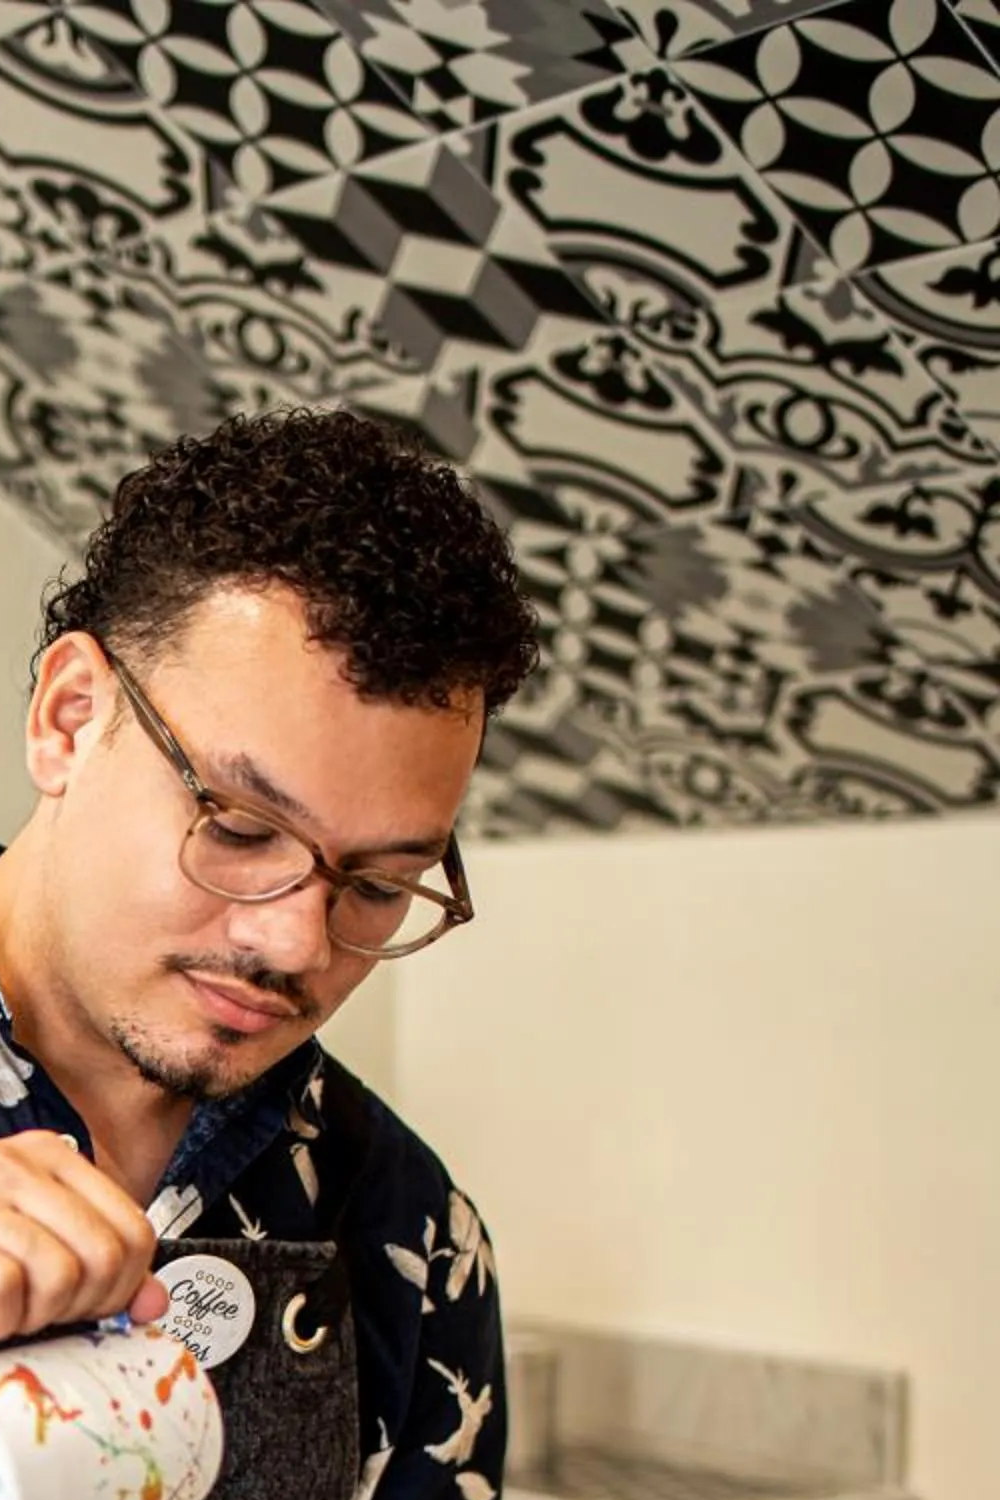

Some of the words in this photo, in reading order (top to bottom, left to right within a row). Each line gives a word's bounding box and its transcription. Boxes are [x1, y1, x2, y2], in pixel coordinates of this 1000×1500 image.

[195, 1270, 235, 1291] GOOD
[169, 1279, 240, 1320] Coffee
[173, 1315, 213, 1336] GOOD
